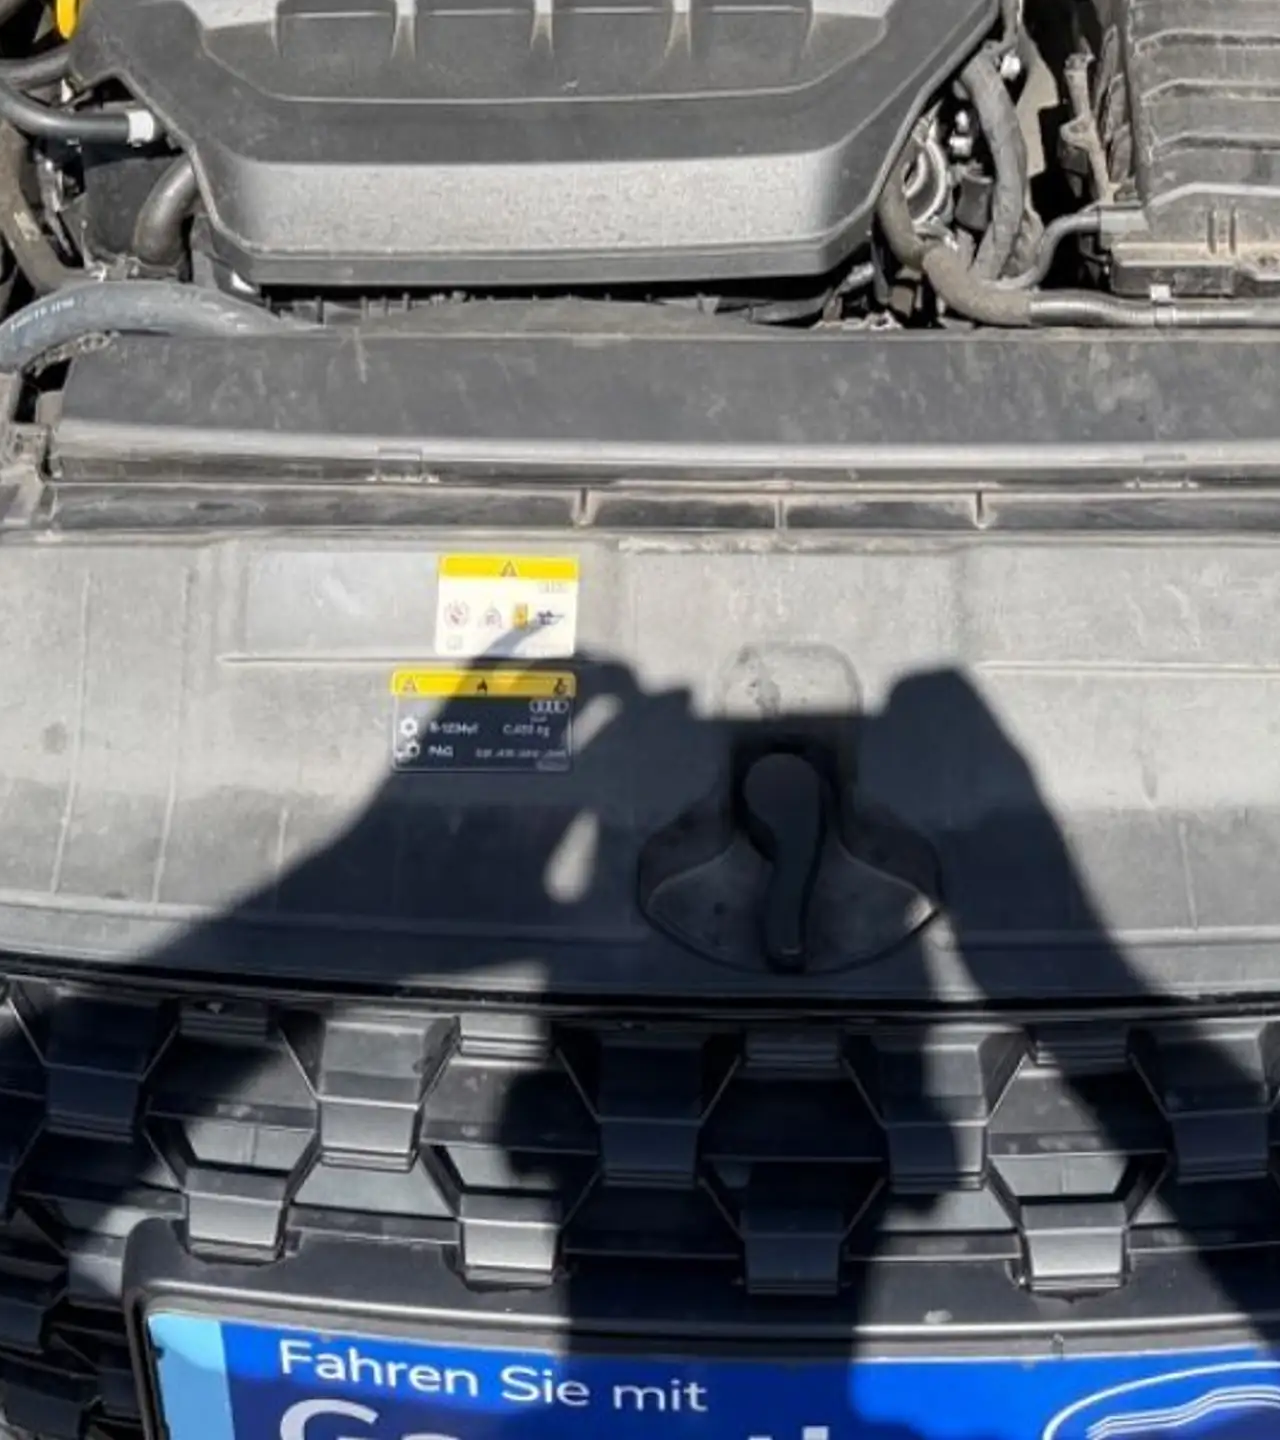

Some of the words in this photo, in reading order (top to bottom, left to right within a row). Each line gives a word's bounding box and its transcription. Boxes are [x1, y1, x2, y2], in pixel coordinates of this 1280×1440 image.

[280, 1339, 479, 1397] Fahren
[500, 1365, 590, 1407] Sie
[613, 1378, 709, 1412] mit
